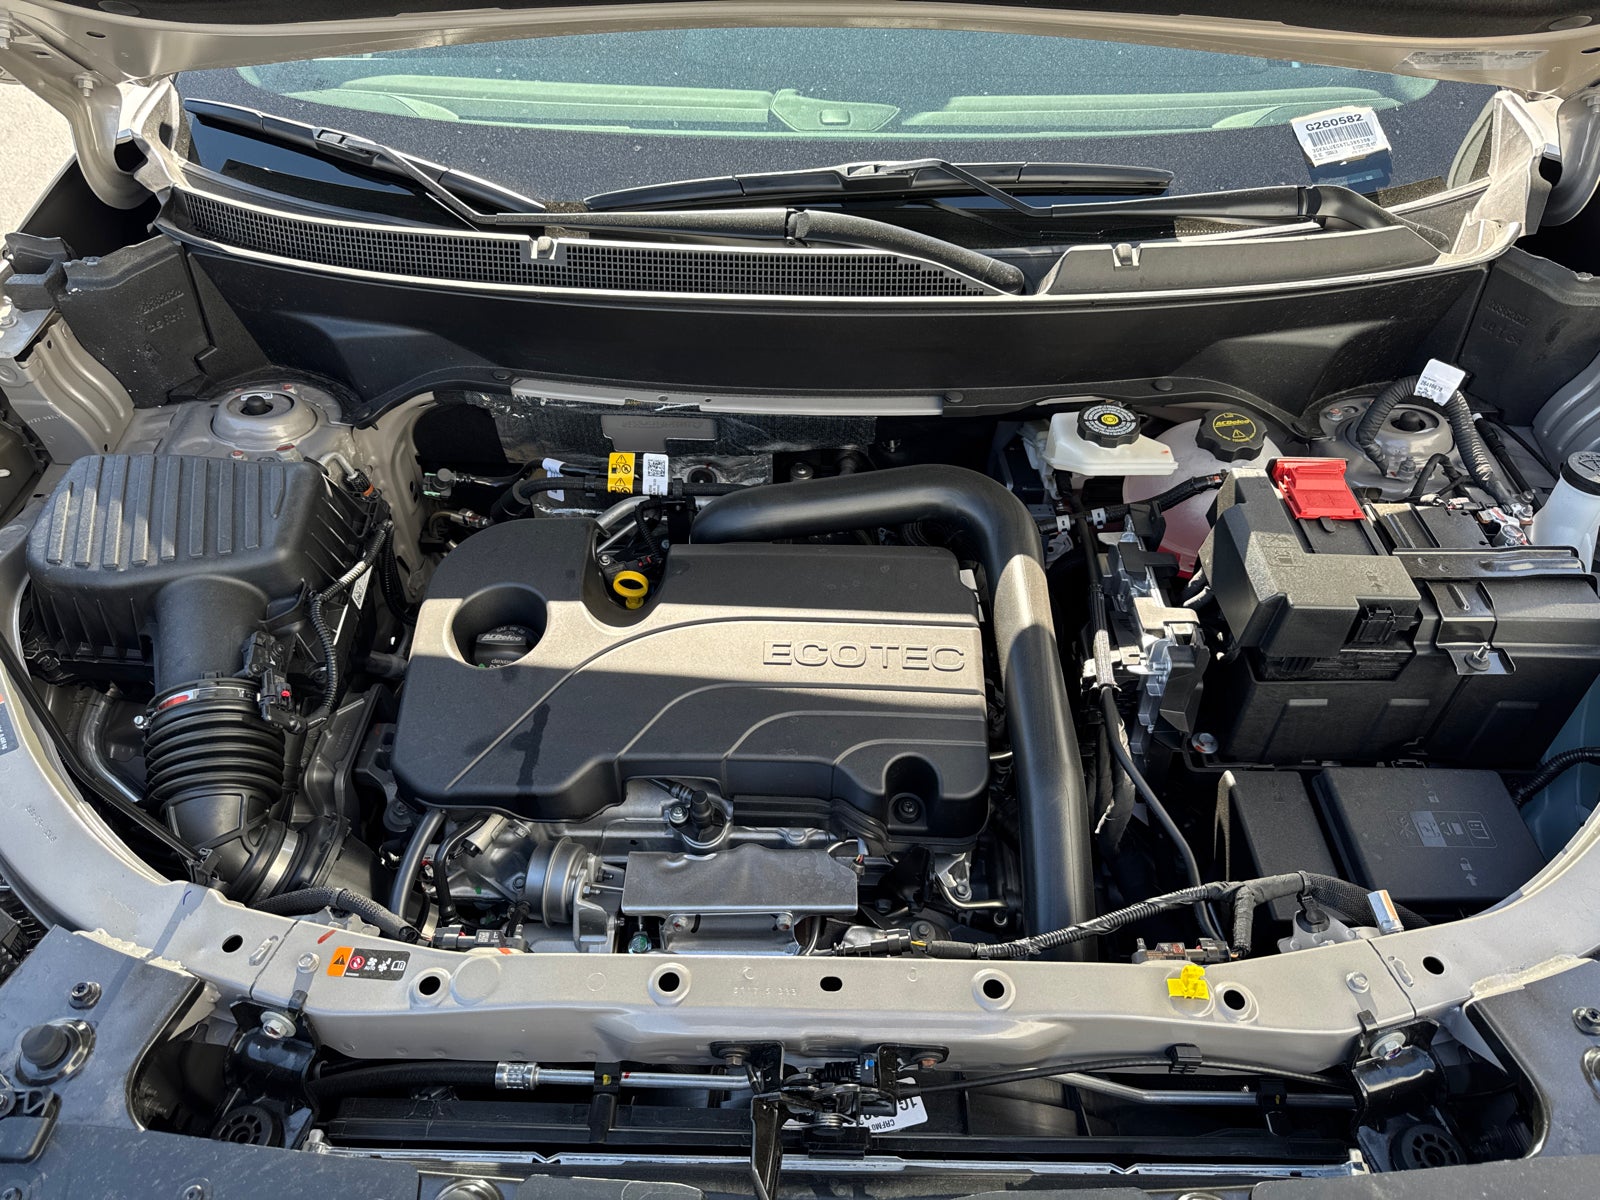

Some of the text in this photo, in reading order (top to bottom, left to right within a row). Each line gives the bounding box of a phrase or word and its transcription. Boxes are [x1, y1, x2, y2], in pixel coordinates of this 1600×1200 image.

[1305, 113, 1364, 132] G260582
[1215, 419, 1250, 428] ACDelco
[763, 640, 965, 672] ECOTEC
[868, 1118, 896, 1131] CRFM0
